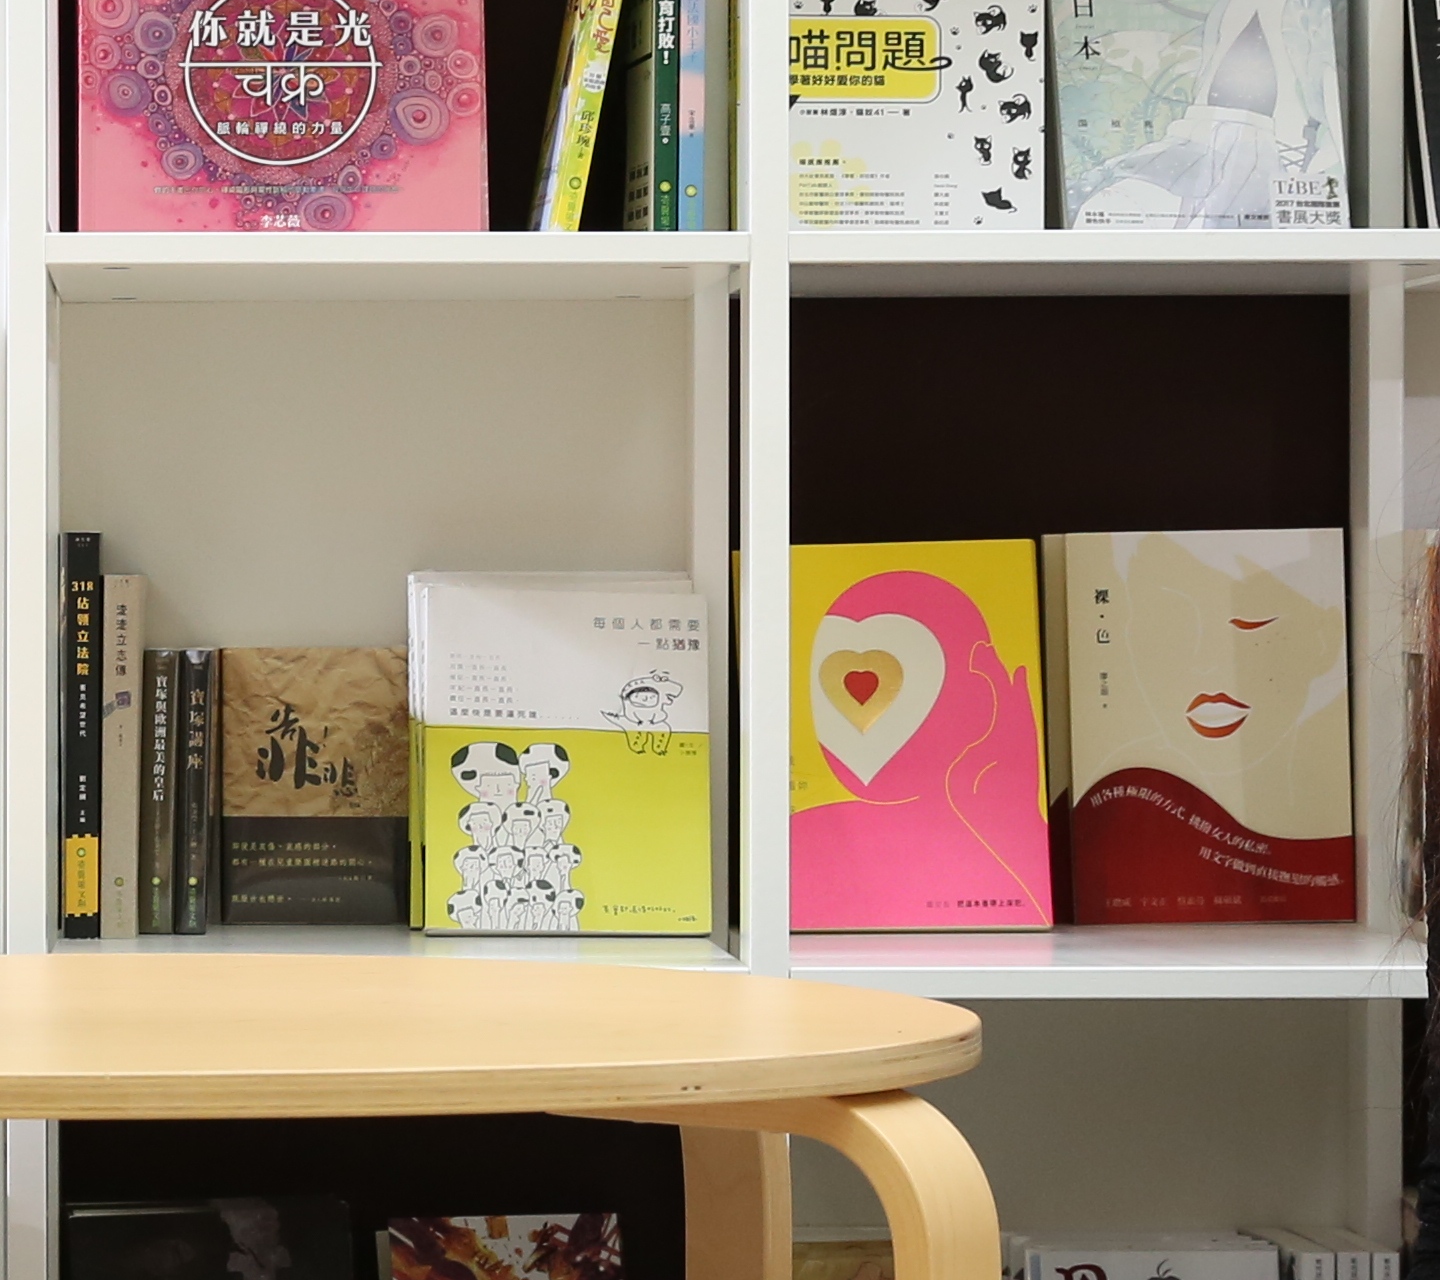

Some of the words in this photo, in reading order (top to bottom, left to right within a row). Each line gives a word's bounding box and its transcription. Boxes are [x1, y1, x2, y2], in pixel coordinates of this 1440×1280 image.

[188, 9, 373, 48] 你就是光
[1275, 210, 1342, 226] 書展大獎
[71, 580, 95, 592] 318
[592, 616, 701, 633] 每個人都需要
[76, 596, 90, 677] 佔領立法院
[637, 637, 702, 651] 一點猶豫
[185, 688, 206, 771] 寶塚講座
